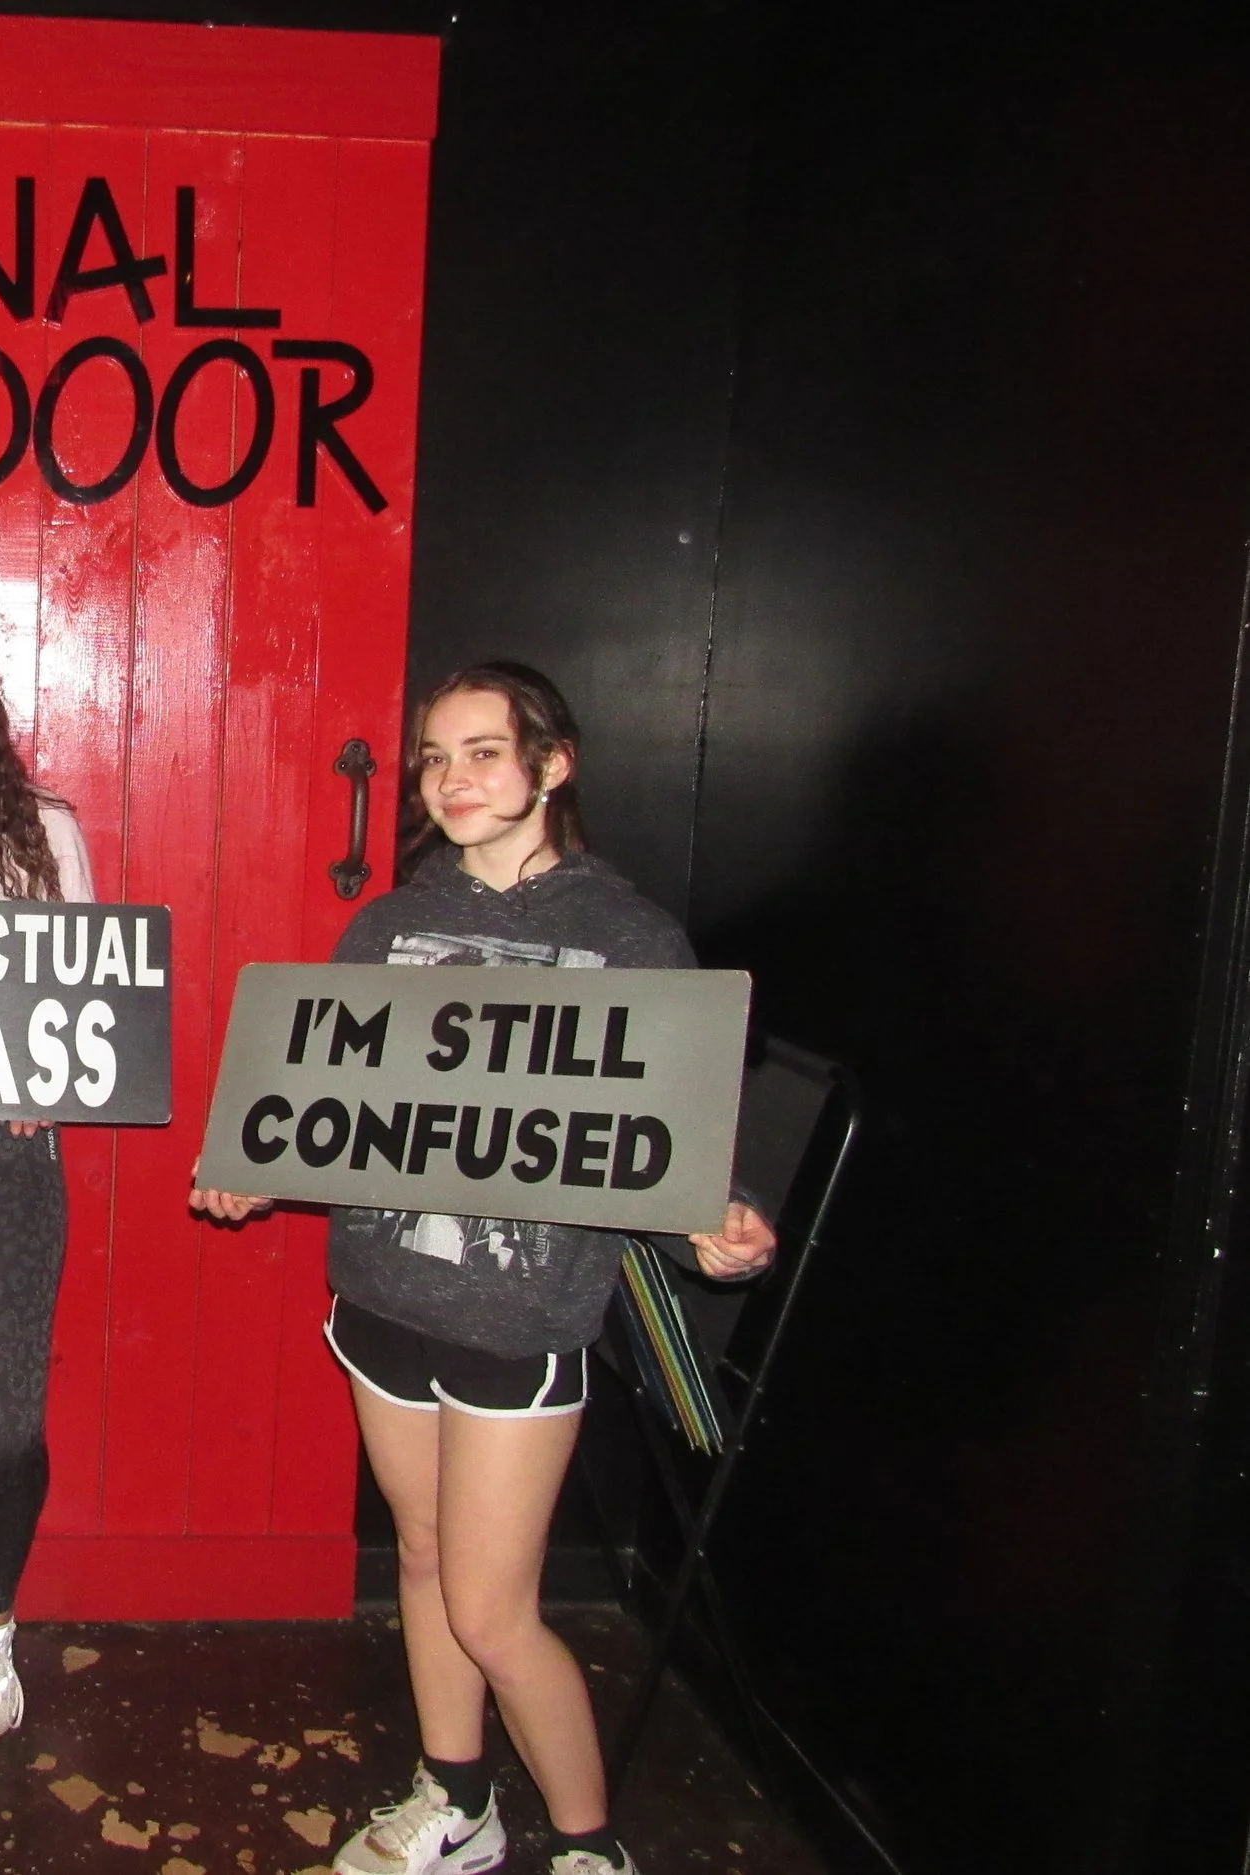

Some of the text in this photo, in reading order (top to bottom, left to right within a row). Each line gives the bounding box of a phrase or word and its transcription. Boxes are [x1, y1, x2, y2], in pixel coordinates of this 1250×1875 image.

[286, 998, 645, 1079] I'M STILL
[241, 1094, 672, 1191] CONFUSED
